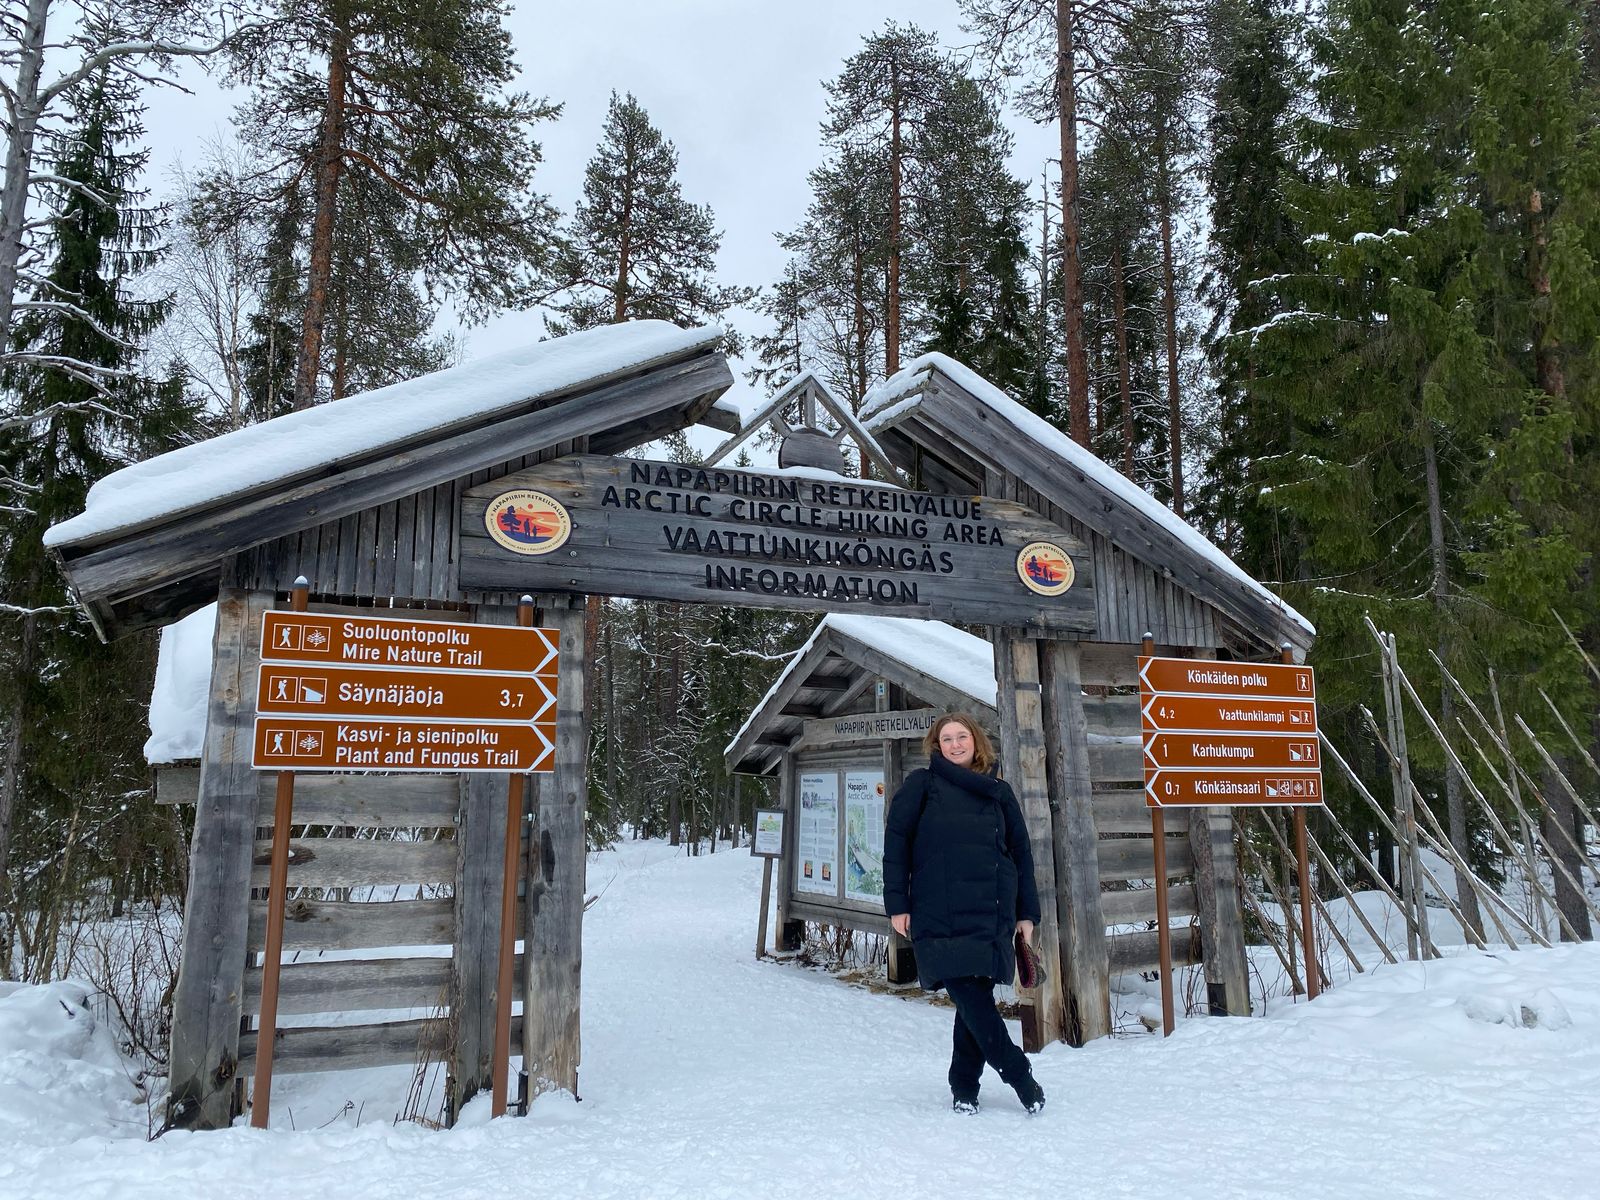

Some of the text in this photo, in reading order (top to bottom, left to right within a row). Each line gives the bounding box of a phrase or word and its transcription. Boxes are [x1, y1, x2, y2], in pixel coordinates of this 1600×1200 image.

[631, 462, 981, 520] NAPAPIIRIN RETKEILYALUE
[601, 485, 1004, 547] ARCTIC CIRCLE HIKING AREA
[663, 525, 954, 574] VAATTUNKIKÖNGÄS
[705, 564, 919, 604] INFORMATION
[342, 621, 470, 645] Suoluontopolku
[342, 642, 483, 666] Mire Nature Trail
[1187, 669, 1268, 688] Könkäiden polku
[338, 682, 444, 708] Säynäjäoja
[499, 689, 524, 709] 3,7
[1218, 708, 1285, 724] Vaattunkilampi
[336, 725, 499, 747] Kasvi- ja sienipolku
[834, 720, 873, 735] NAPAPIIRN
[335, 747, 519, 768] Plant and Fungus Trail
[1163, 743, 1168, 758] 1
[1192, 743, 1255, 760] Karhukumpu
[1194, 780, 1261, 795] Könkäänsaari
